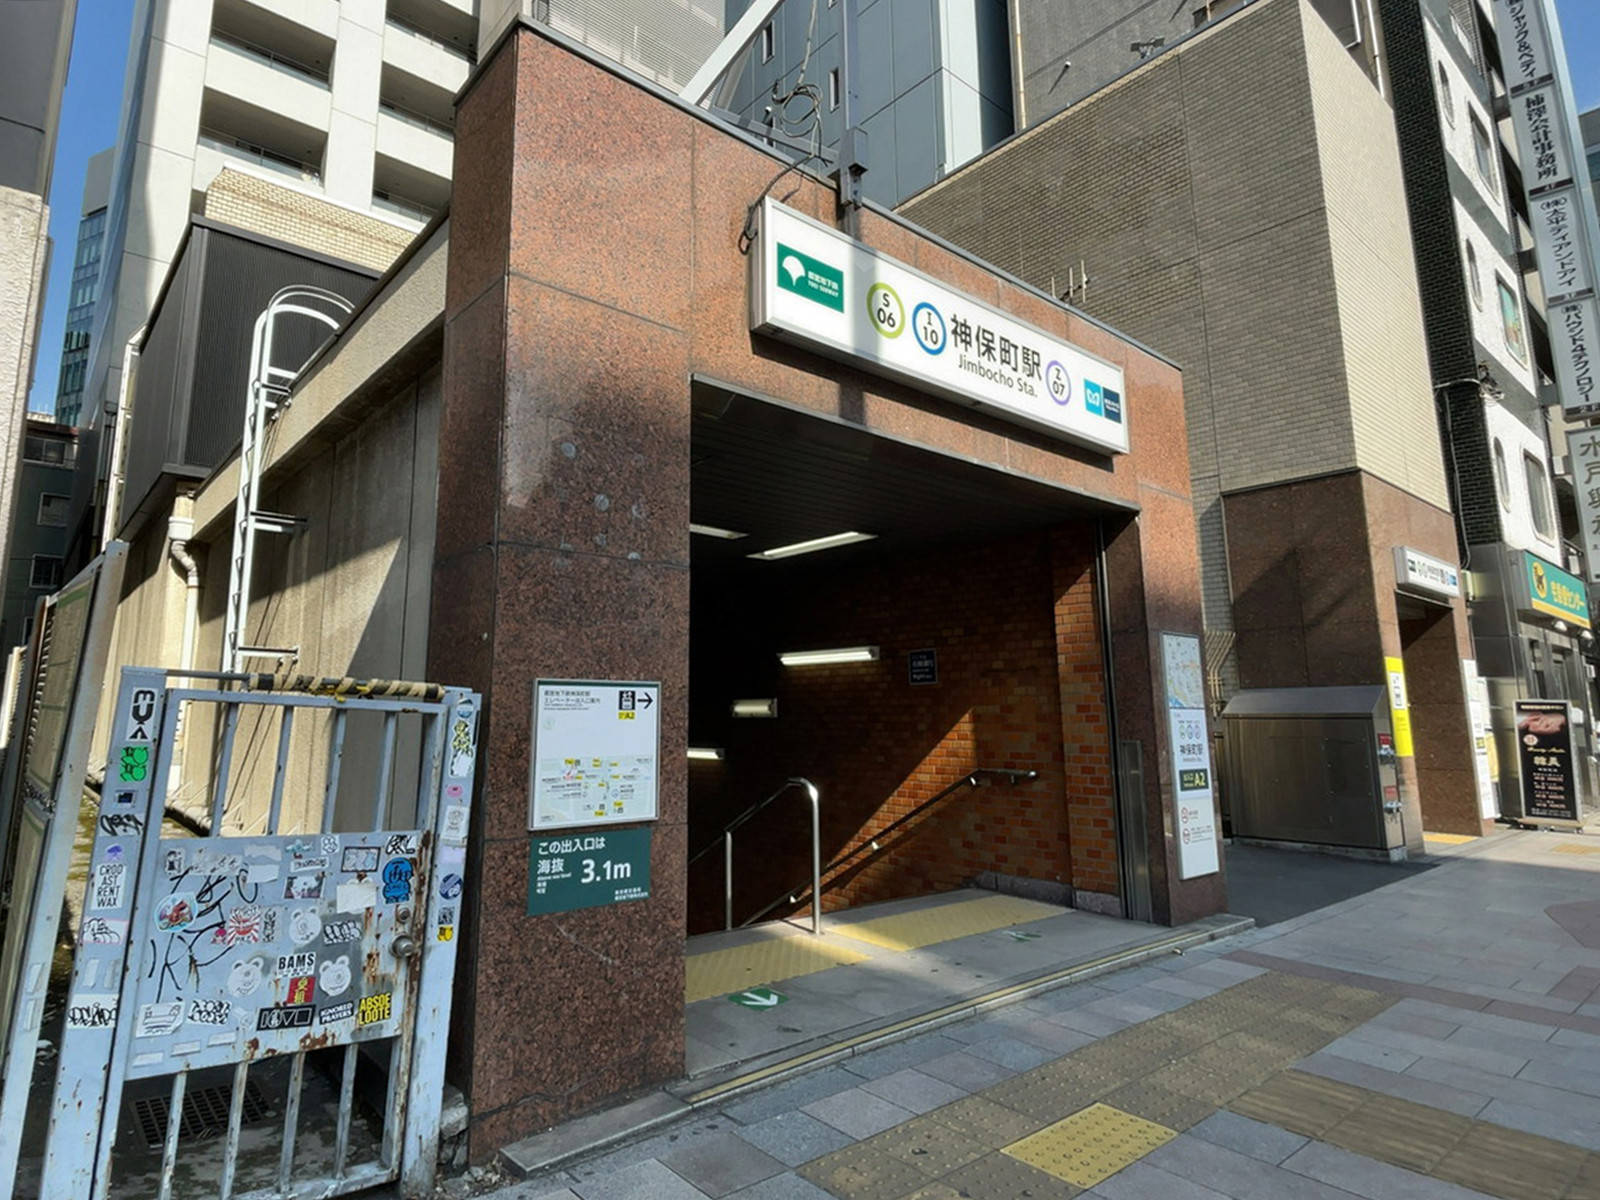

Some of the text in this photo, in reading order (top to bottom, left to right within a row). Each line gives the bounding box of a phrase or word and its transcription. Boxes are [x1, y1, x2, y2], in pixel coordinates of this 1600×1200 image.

[882, 293, 890, 307] S
[877, 307, 896, 328] 06
[926, 311, 933, 326] I
[922, 326, 939, 345] 10
[951, 313, 1042, 381] 神保町駅
[958, 354, 1038, 398] Jimbocho Sta.
[1055, 367, 1061, 381] Z
[1052, 380, 1065, 396] 07
[1194, 771, 1206, 787] A2
[537, 836, 606, 855] この出入口は
[537, 858, 632, 884] 海抜 3.1m
[97, 885, 120, 898] RENT
[97, 896, 117, 908] WAX
[278, 952, 315, 970] BAMS
[358, 1007, 390, 1026] LOOTE
